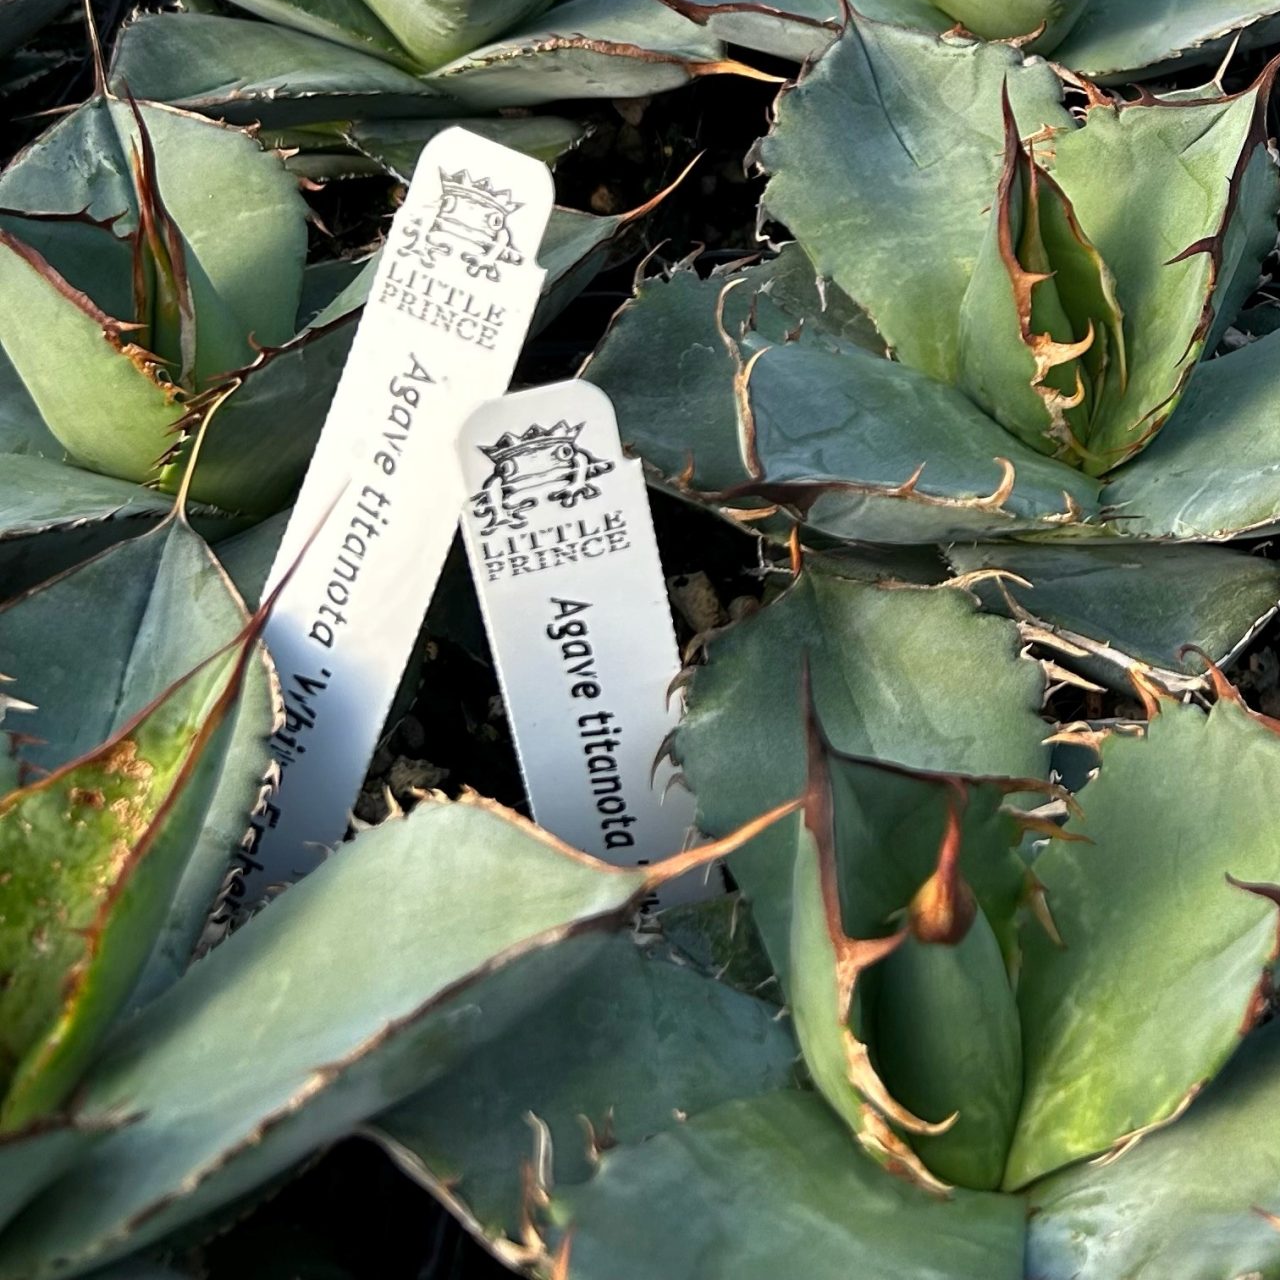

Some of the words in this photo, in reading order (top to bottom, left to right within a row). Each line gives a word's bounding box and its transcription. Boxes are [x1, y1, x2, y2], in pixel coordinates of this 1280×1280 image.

[378, 280, 499, 351] PRINCE
[386, 260, 507, 327] LITTLE
[373, 351, 437, 476] Agave
[308, 485, 392, 649] titanota
[481, 509, 628, 561] LITTLE
[484, 529, 632, 582] PRINCE
[545, 596, 602, 700] Agave
[577, 710, 638, 851] titanota
